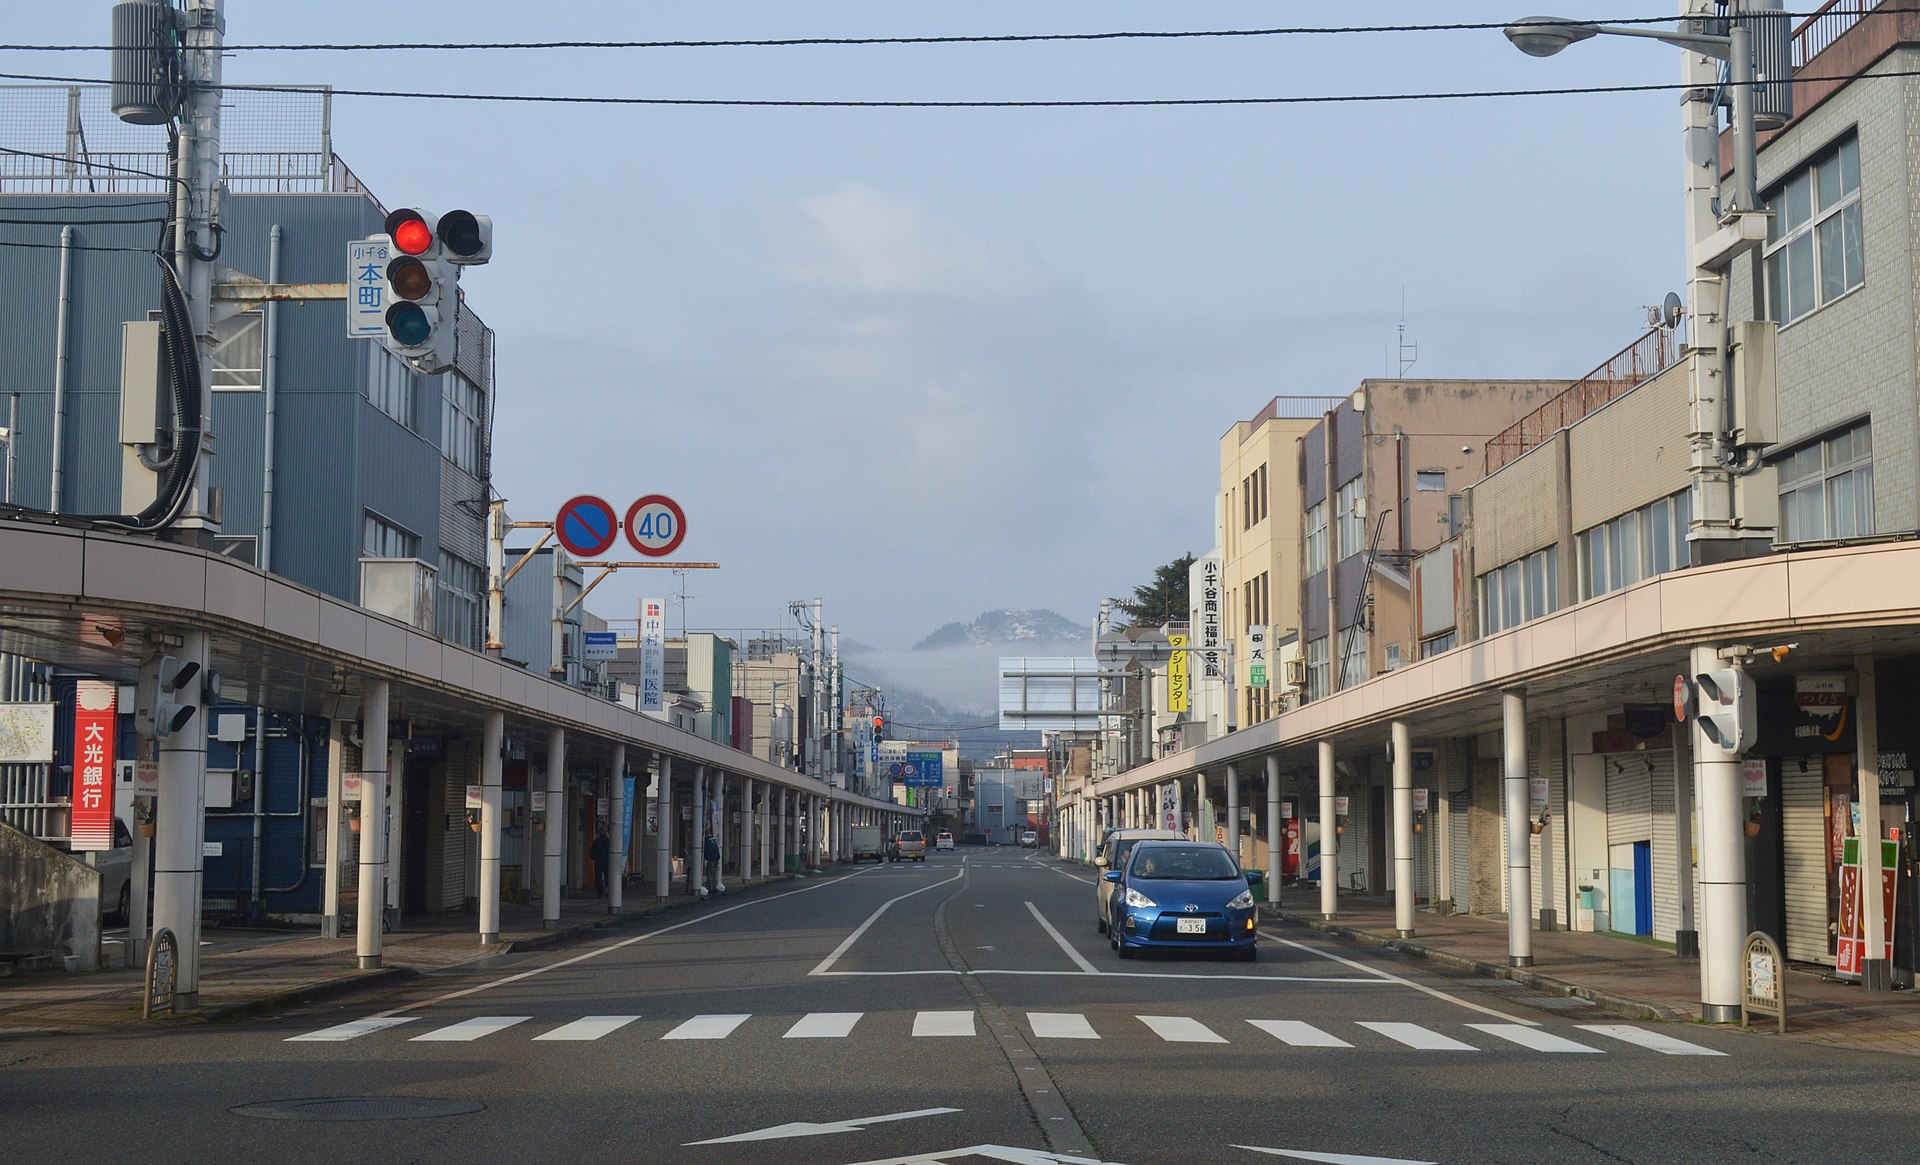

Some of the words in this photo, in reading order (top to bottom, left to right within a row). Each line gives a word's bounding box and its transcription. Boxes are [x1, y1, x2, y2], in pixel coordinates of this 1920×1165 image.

[353, 247, 388, 260] 小千谷
[638, 512, 672, 540] 40
[646, 619, 660, 646] 中村
[1204, 561, 1218, 677] 小千谷商工福祉会館
[644, 678, 659, 705] 医院
[1803, 693, 1839, 705] つむぎ
[82, 722, 105, 809] 大光銀行
